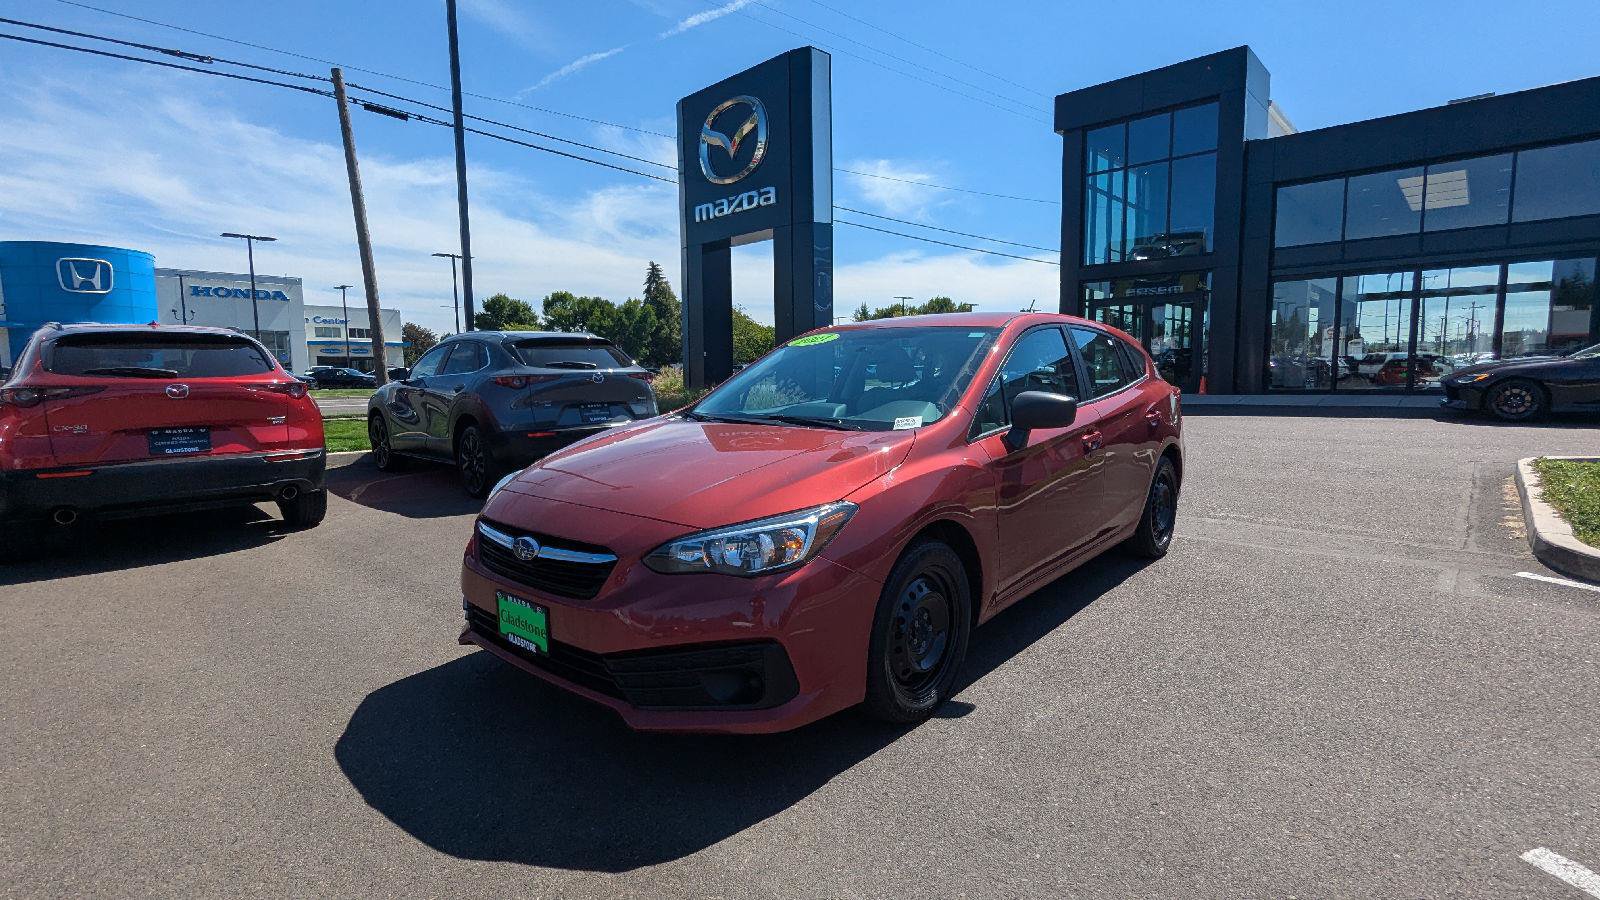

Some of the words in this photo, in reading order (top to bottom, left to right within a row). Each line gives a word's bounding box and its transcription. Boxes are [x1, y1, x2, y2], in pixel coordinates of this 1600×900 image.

[190, 286, 290, 301] HONDA
[313, 316, 350, 324] Center
[507, 595, 530, 608] MAZDA
[501, 609, 546, 638] Gladstone
[508, 633, 537, 653] GLADSTONE
